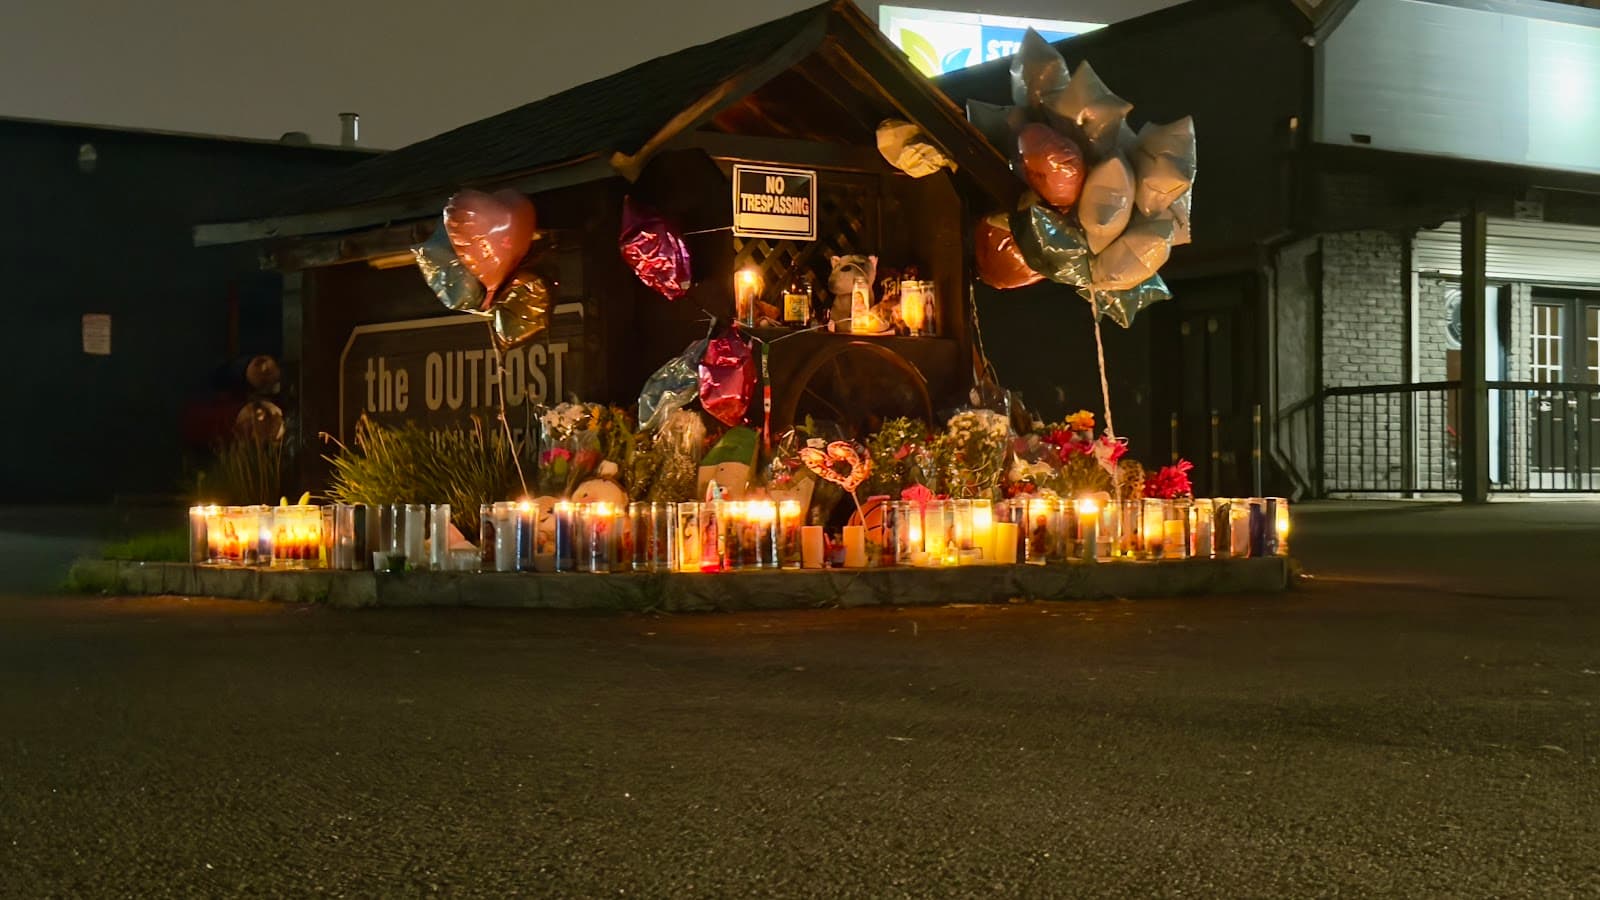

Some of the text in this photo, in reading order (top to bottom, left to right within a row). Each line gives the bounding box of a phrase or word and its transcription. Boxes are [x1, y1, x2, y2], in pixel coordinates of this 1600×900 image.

[766, 175, 784, 194] NO
[741, 193, 809, 215] TRESPASSING
[365, 343, 568, 412] the OUTPOST
